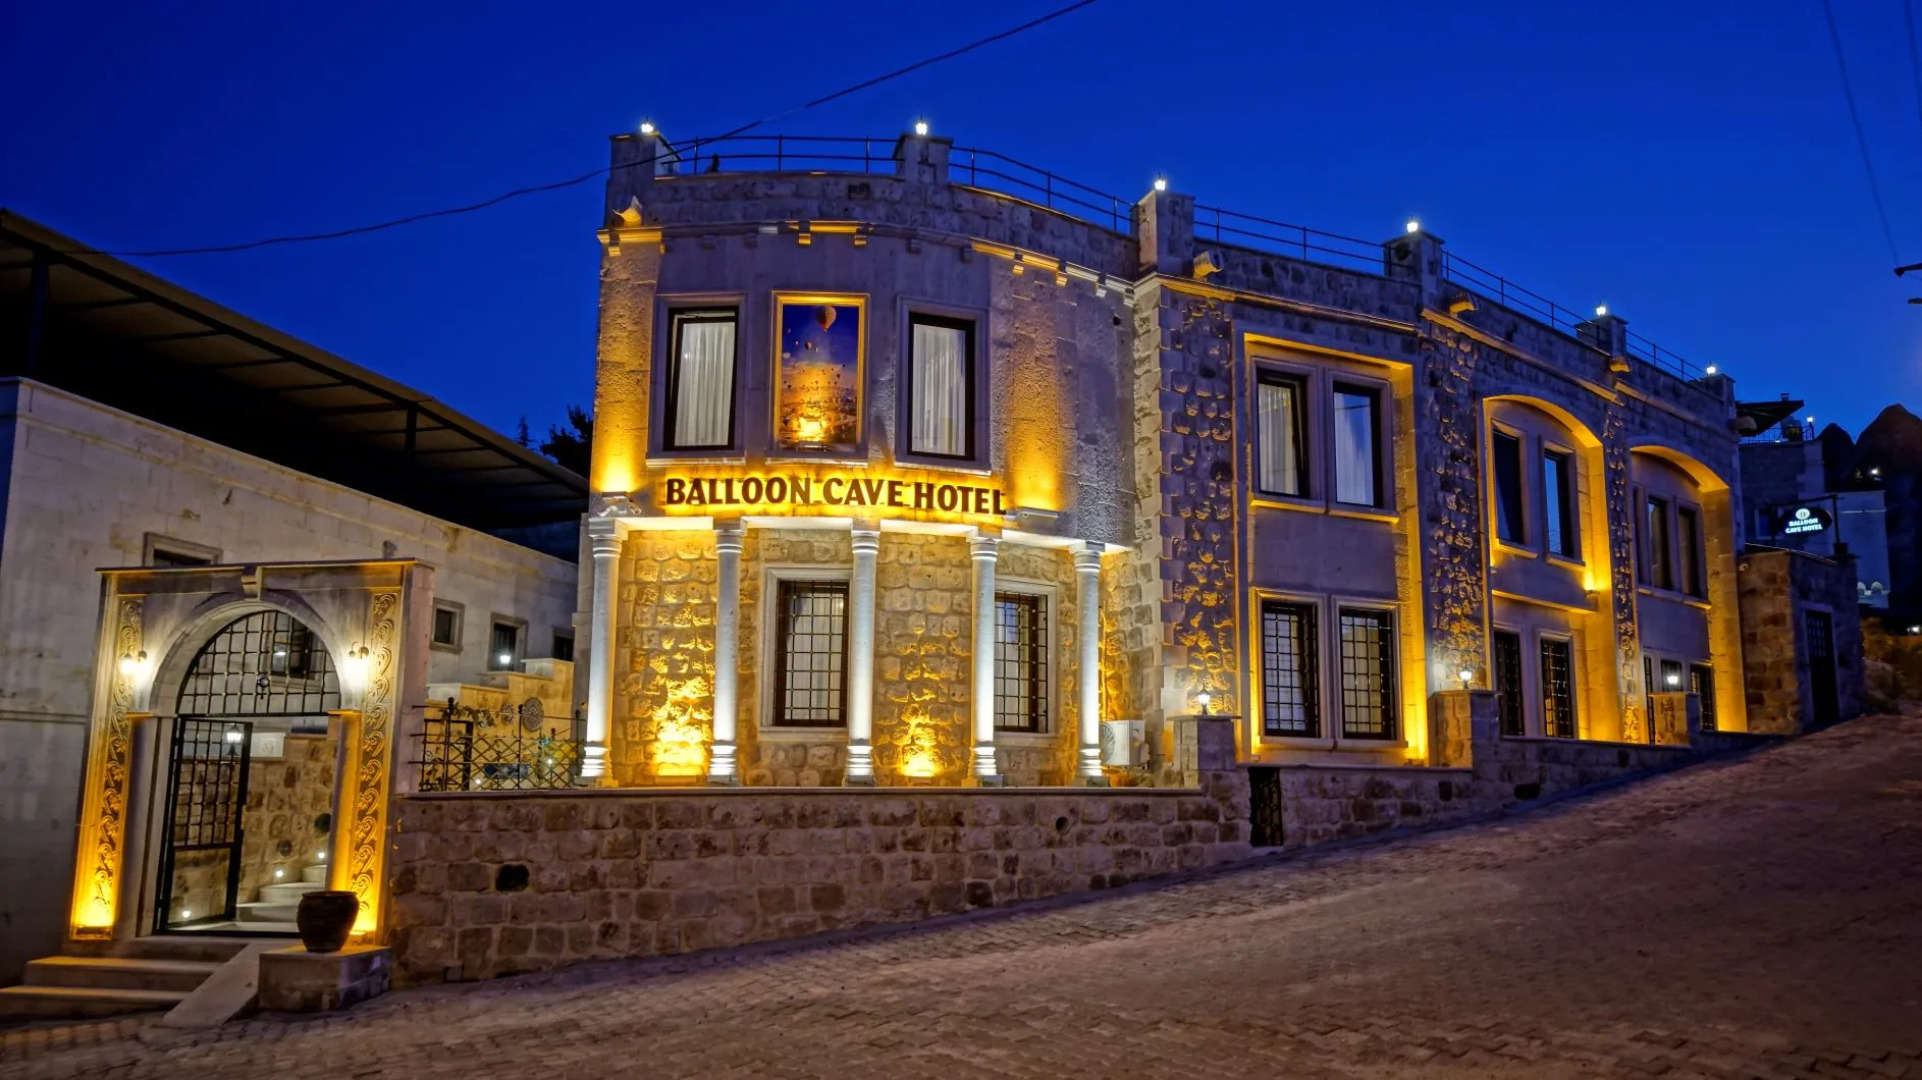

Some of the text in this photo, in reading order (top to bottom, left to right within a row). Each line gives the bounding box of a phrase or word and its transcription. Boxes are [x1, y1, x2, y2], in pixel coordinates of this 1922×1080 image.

[666, 477, 1007, 515] BALLOON CAVE HOTEL
[1788, 518, 1818, 527] BALLOON
[1785, 524, 1823, 534] CAVE HOTEL
